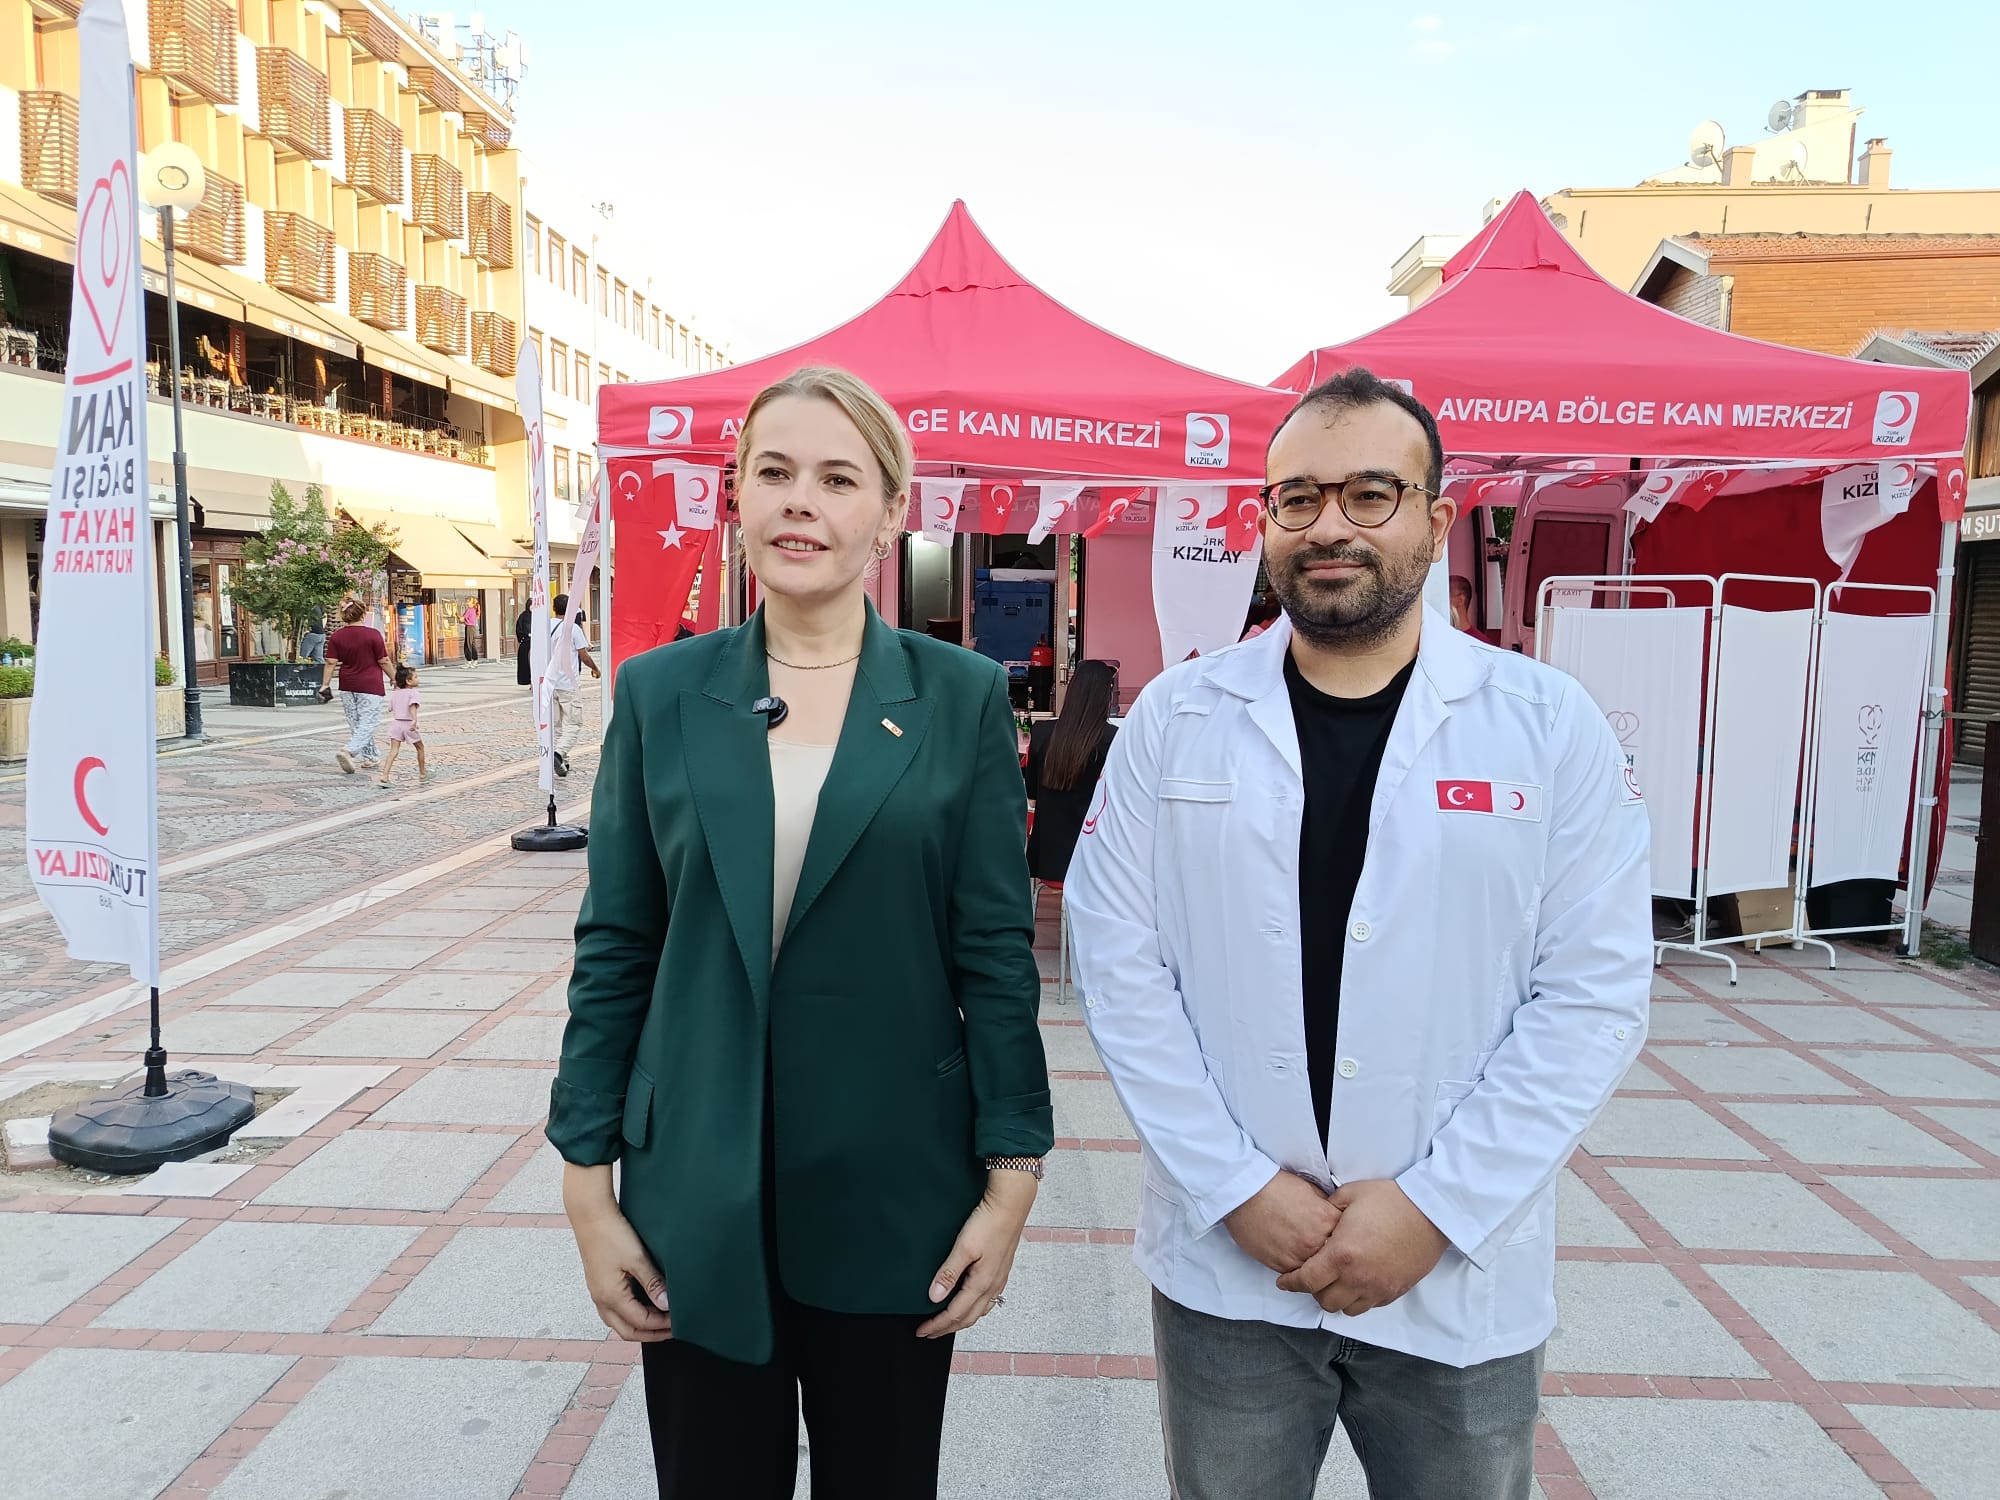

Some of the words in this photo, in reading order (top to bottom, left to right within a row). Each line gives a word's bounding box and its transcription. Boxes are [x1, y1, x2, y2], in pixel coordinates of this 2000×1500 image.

[1437, 398, 1549, 423] AVRUPA
[1556, 395, 1656, 425] BÖLGE
[1663, 402, 1723, 426] KAN
[1732, 401, 1854, 429] MERKEZİ
[958, 410, 1020, 438] KAN
[1030, 415, 1161, 449] MERKEZİ
[1876, 435, 1905, 444] KIZILAY
[1190, 456, 1223, 466] KIZILAY
[1863, 472, 1879, 483] TÜ
[1202, 534, 1225, 547] ÜRK
[1172, 546, 1243, 564] KIZILAY
